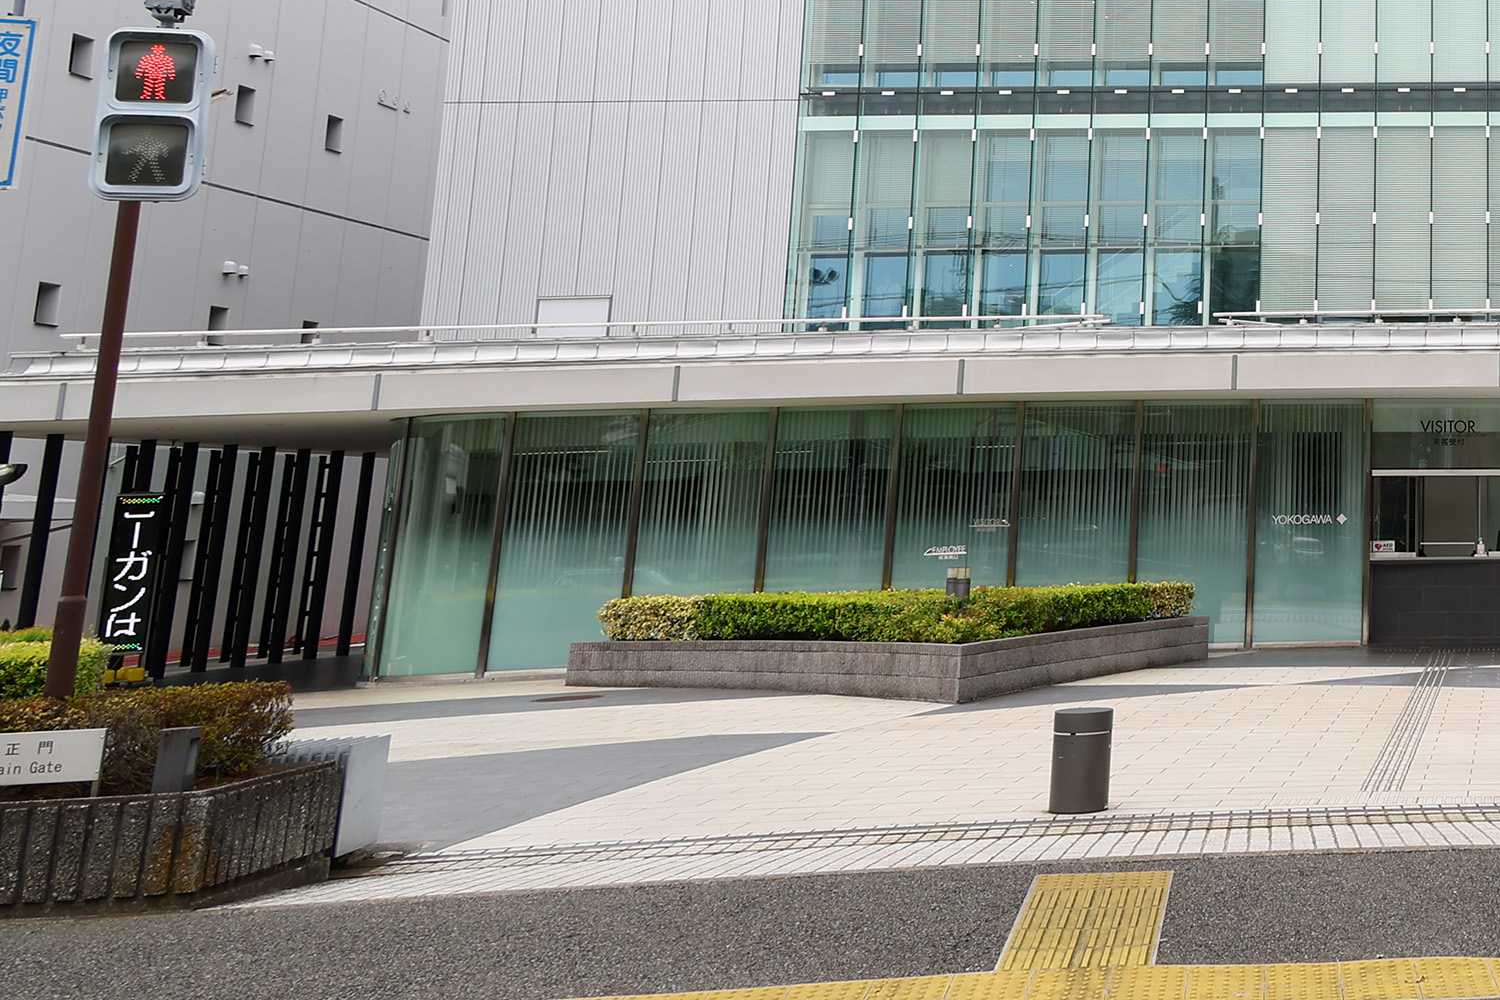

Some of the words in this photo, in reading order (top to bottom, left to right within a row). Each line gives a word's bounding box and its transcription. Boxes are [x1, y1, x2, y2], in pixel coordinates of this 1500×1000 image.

[1420, 420, 1476, 433] VISITOR
[1272, 514, 1333, 525] YOKOGAWA
[0, 761, 22, 776] ain
[29, 761, 63, 774] Gate
